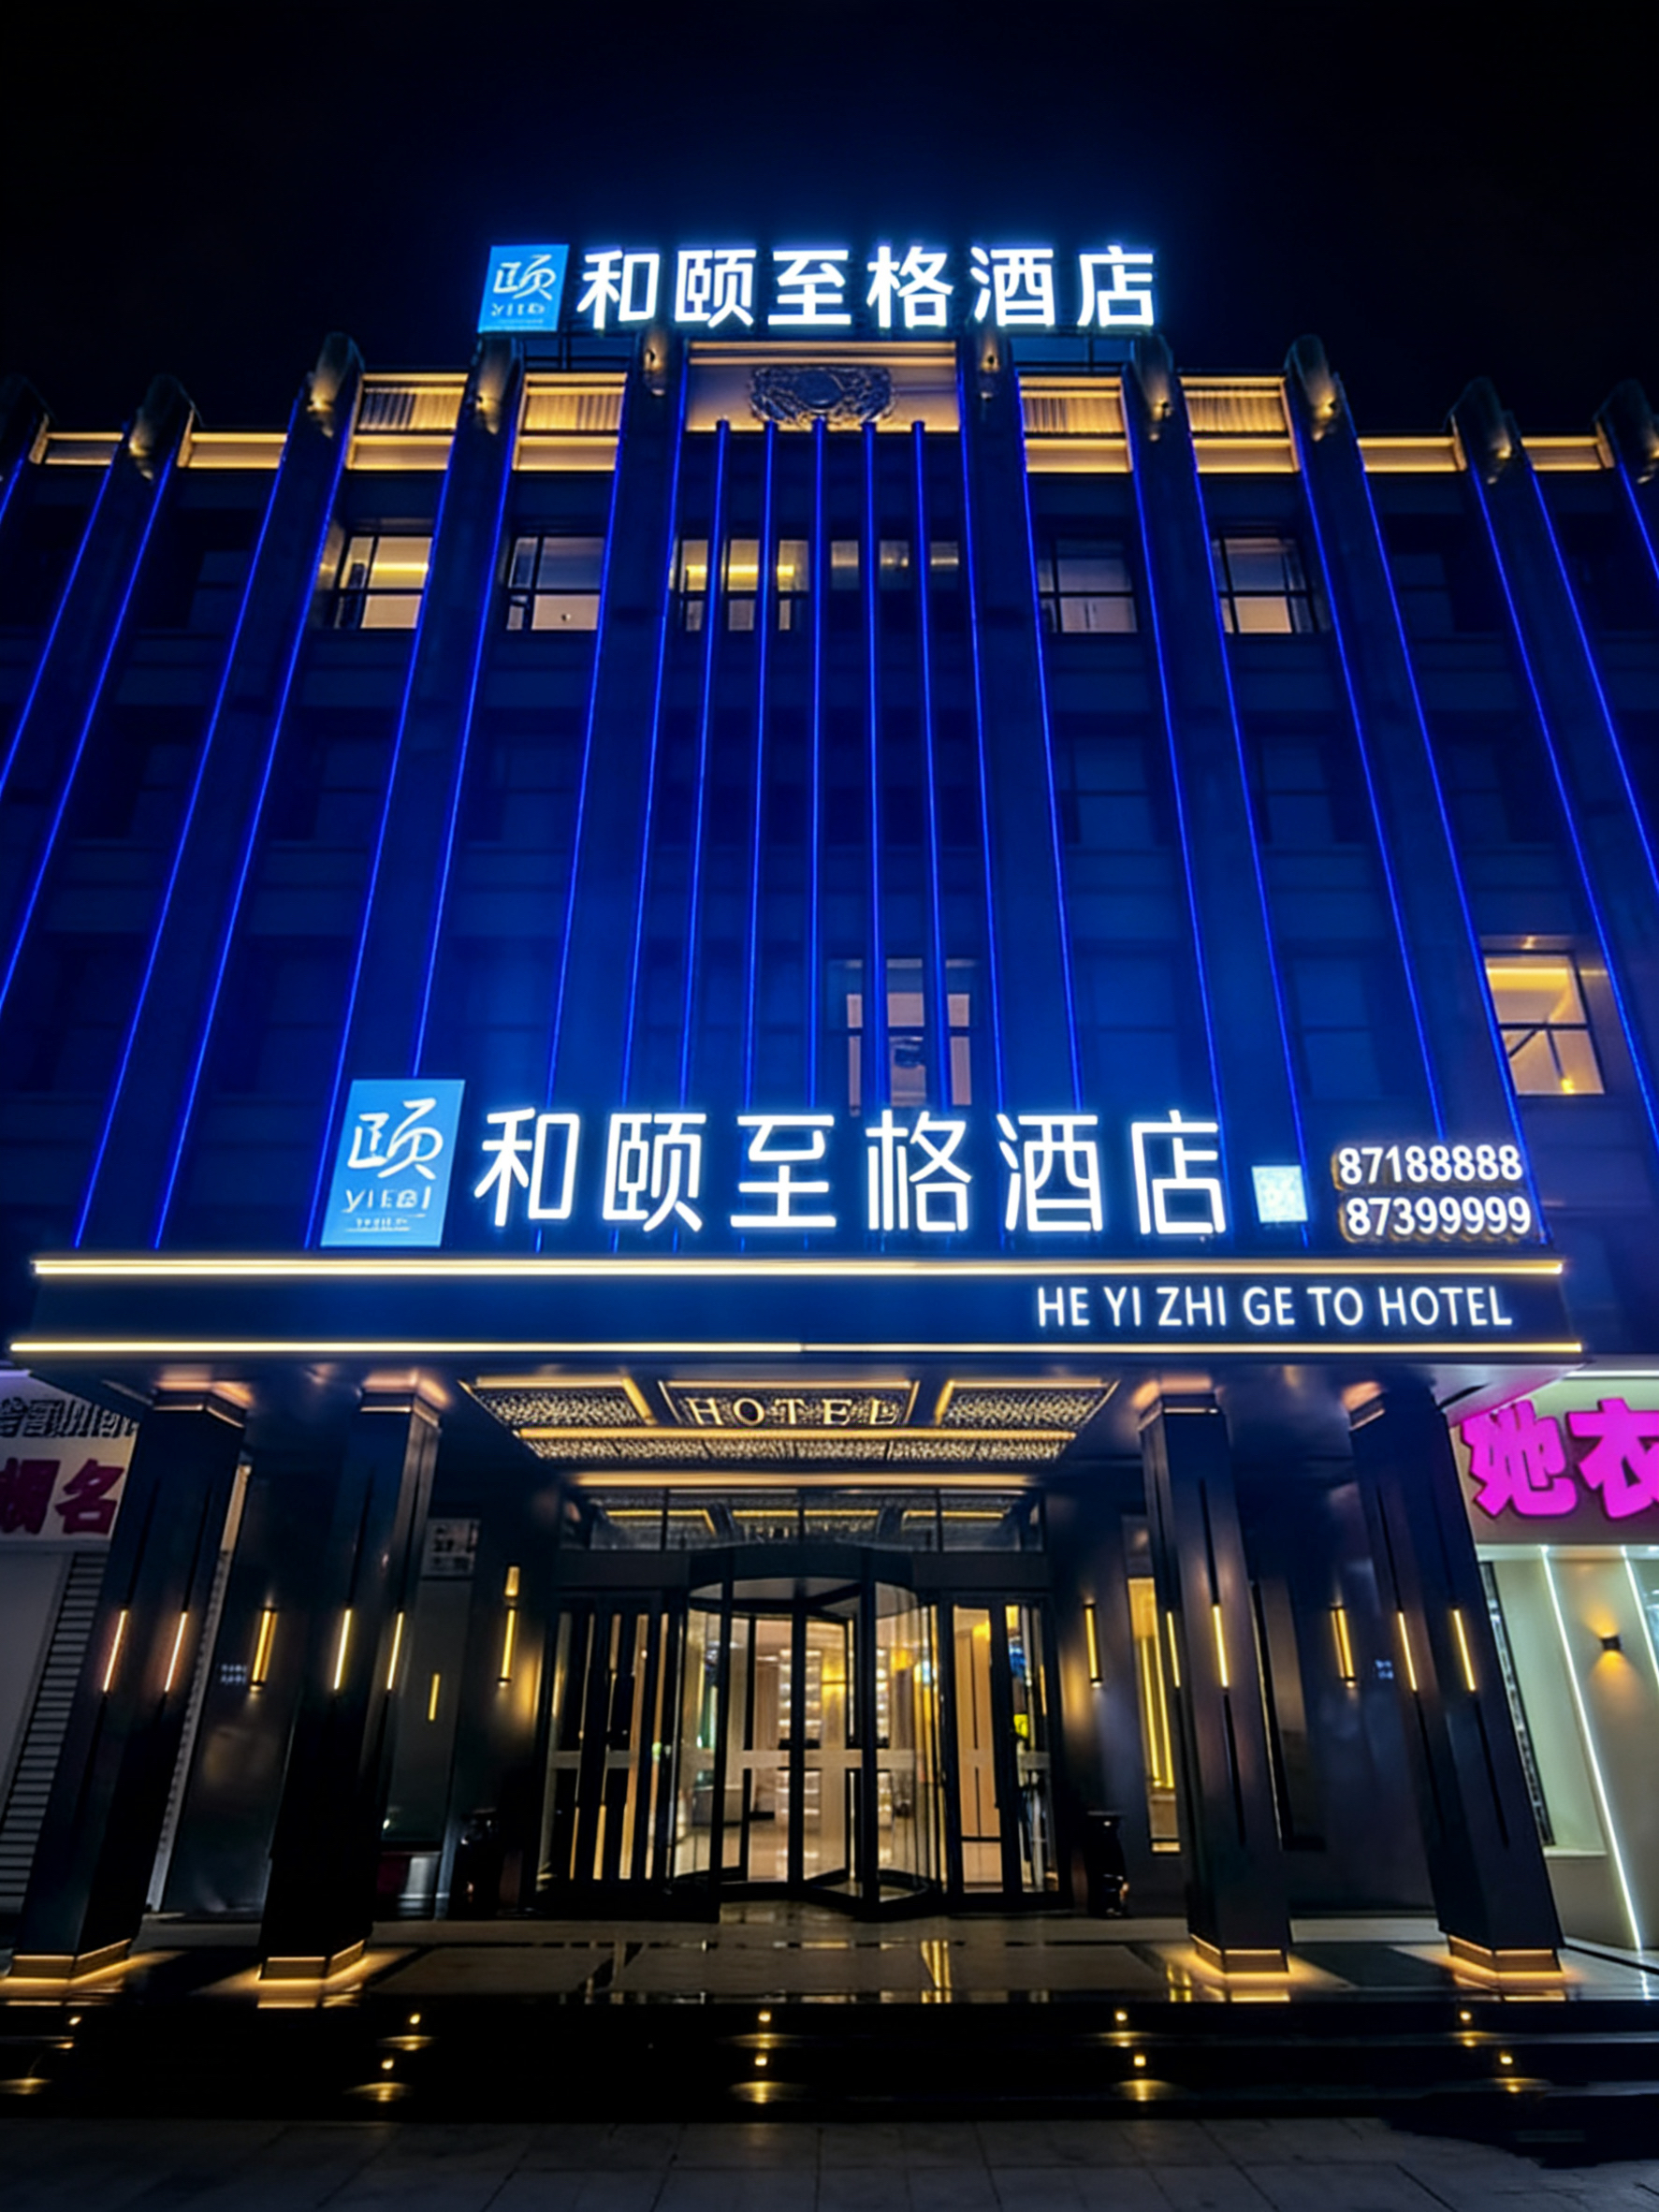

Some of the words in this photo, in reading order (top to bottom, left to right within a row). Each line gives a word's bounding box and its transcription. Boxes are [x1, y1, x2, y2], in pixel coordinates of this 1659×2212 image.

[577, 246, 1155, 329] 和颐至格酒店
[474, 1107, 1226, 1234] 和颐至格酒店
[1338, 1144, 1522, 1185] 87188888
[1346, 1196, 1531, 1236] 87399999
[1038, 1287, 1090, 1327] HE
[1103, 1287, 1141, 1327] YI
[1157, 1287, 1226, 1326] ZHI
[1243, 1287, 1295, 1326] GE
[1306, 1287, 1363, 1326] TO
[1378, 1287, 1512, 1326] HOTEL
[685, 1398, 899, 1426] HOTEL
[1462, 1398, 1659, 1519] 她衣
